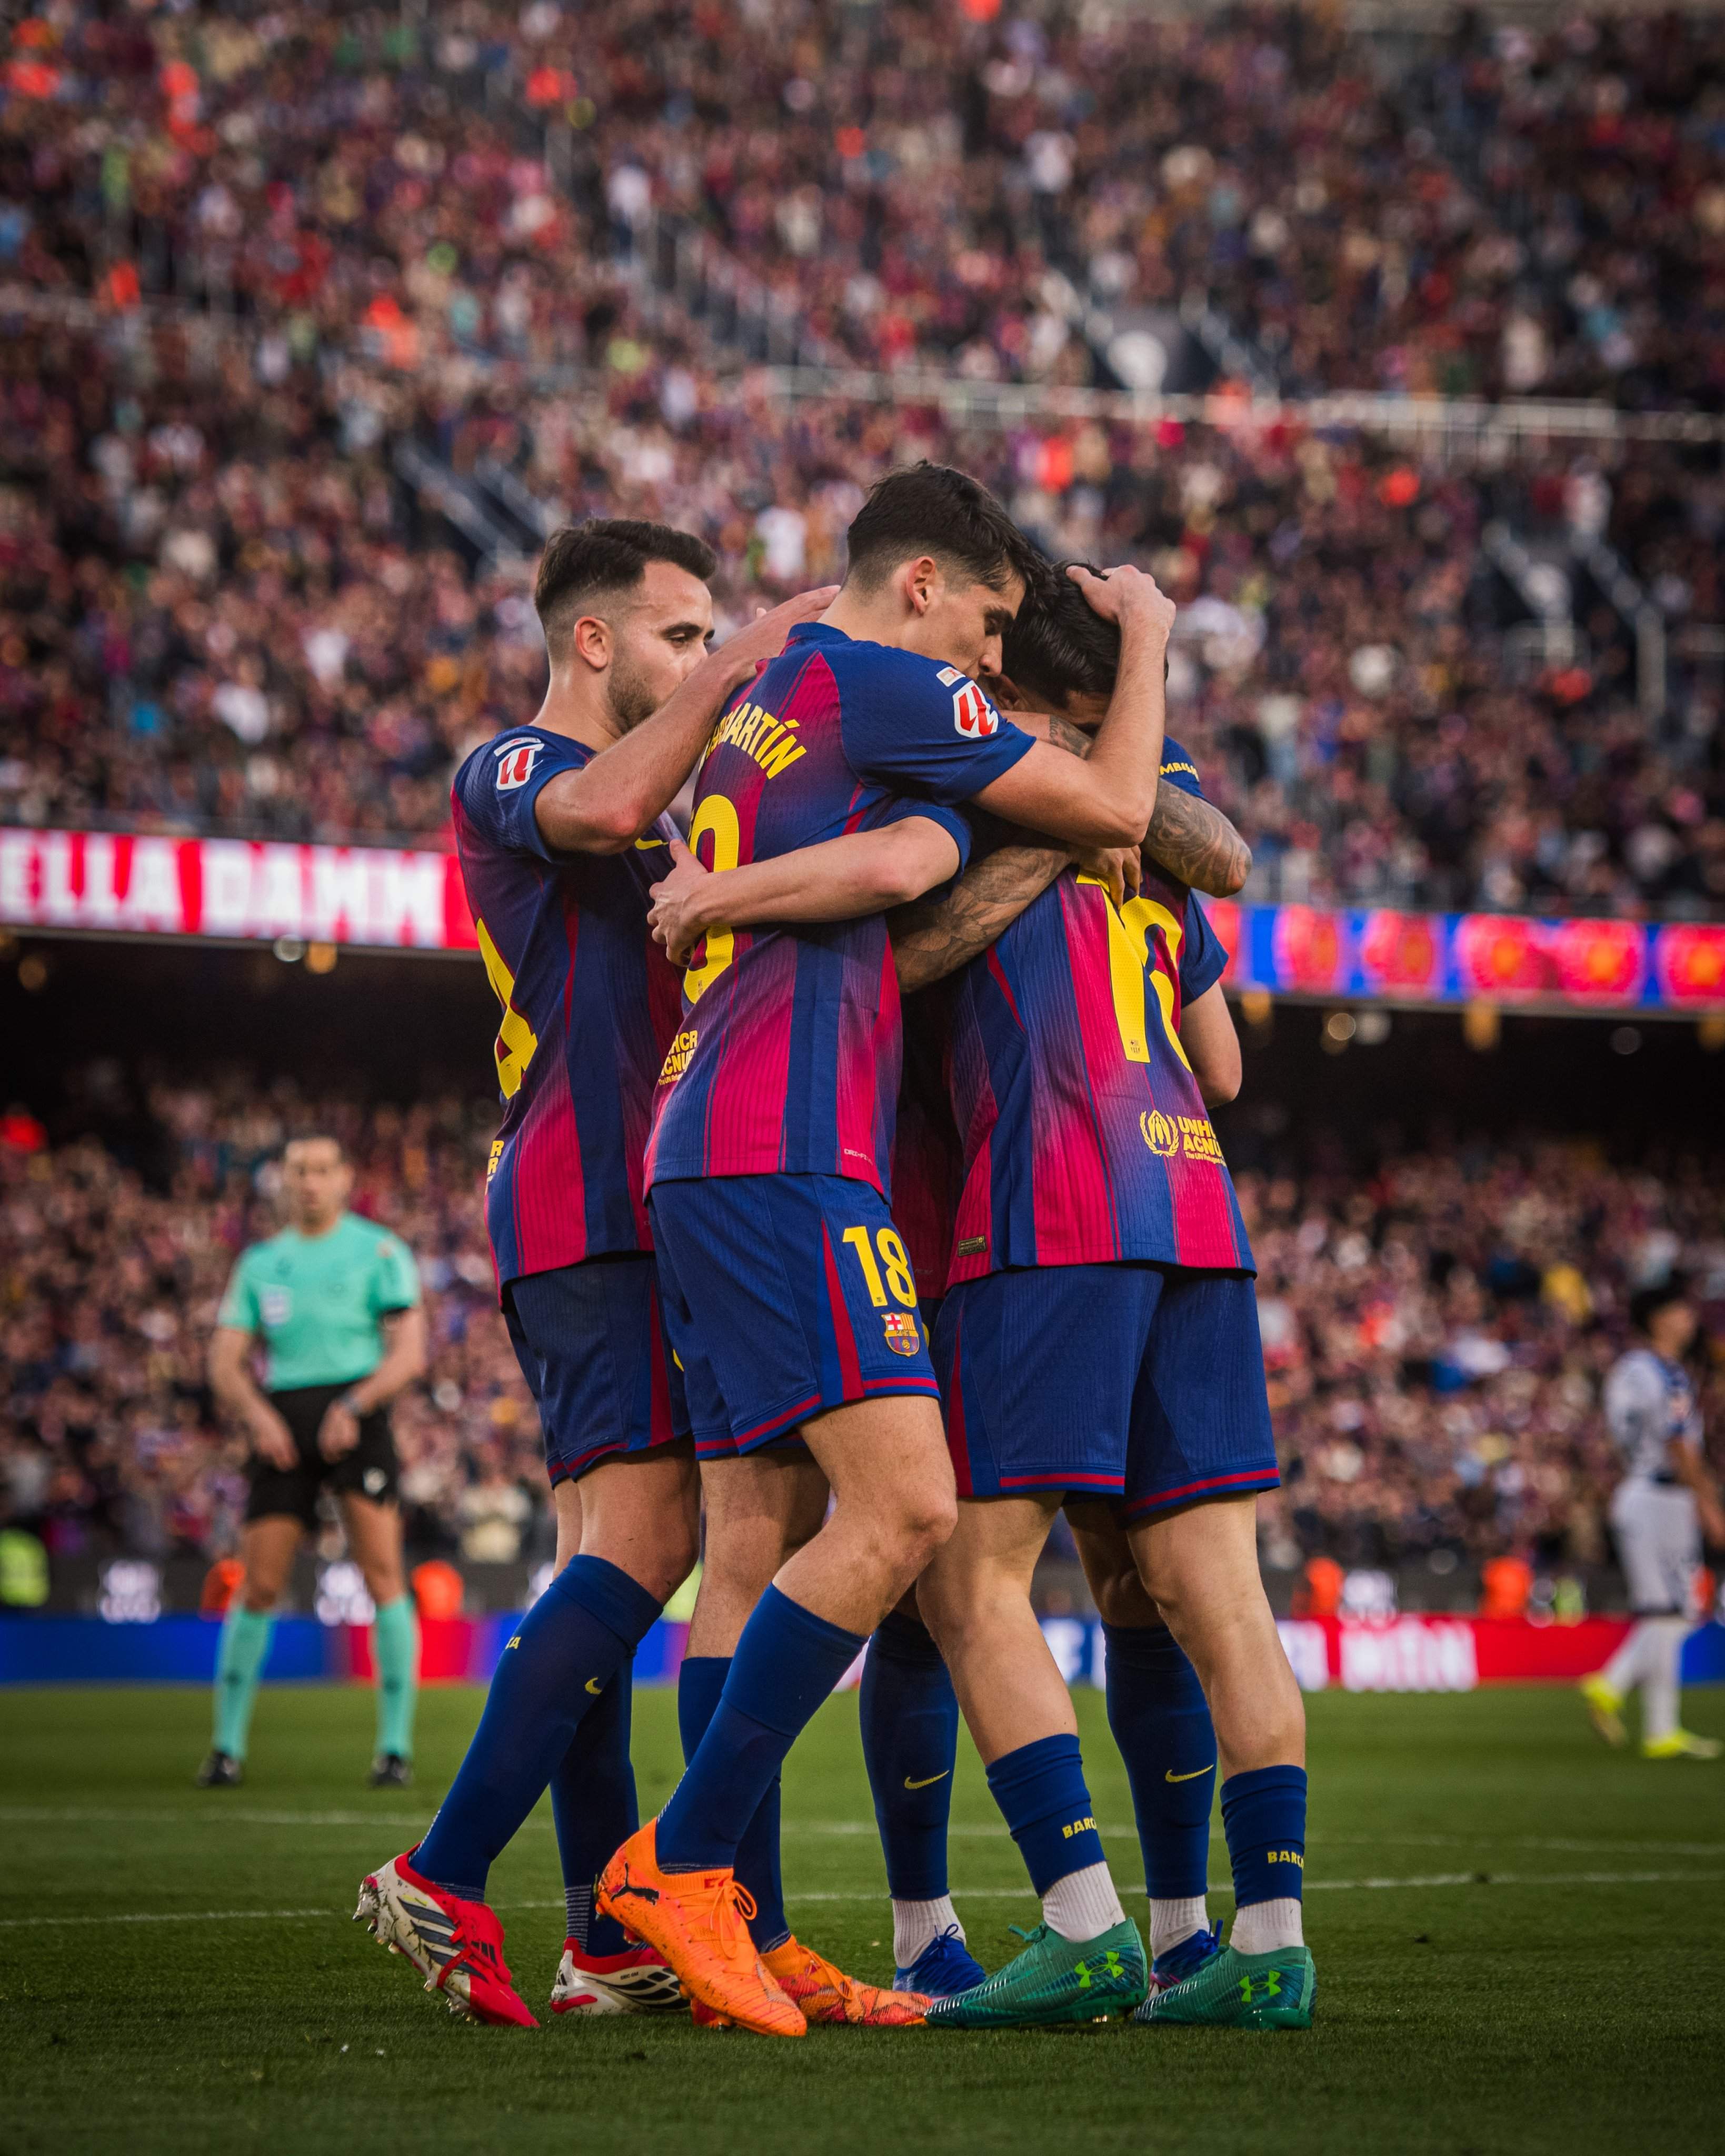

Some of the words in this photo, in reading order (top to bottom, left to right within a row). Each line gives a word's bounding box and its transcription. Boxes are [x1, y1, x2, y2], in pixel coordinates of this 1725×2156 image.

[204, 839, 442, 946] DAMM
[1183, 1134, 1223, 1157] ACNU
[842, 1226, 918, 1308] 18
